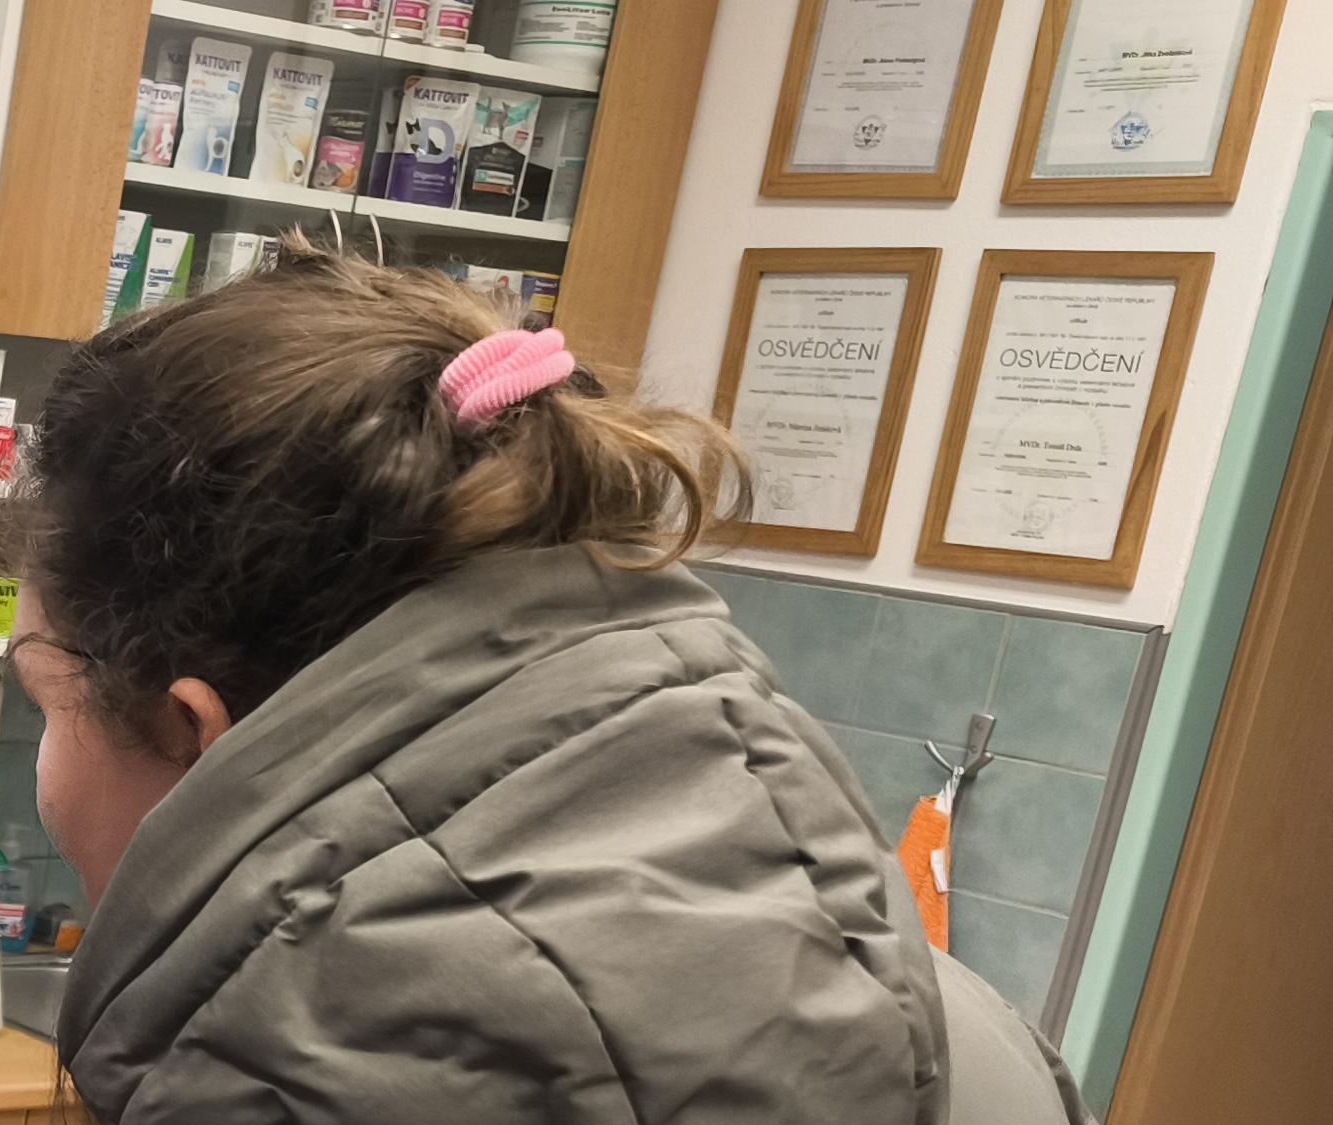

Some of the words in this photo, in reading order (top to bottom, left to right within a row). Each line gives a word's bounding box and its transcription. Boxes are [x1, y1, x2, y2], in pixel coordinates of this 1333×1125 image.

[413, 86, 470, 105] KATTOVIT
[758, 336, 883, 361] OSVĚDČENÍ
[999, 346, 1145, 374] OSVĚDČENÍ
